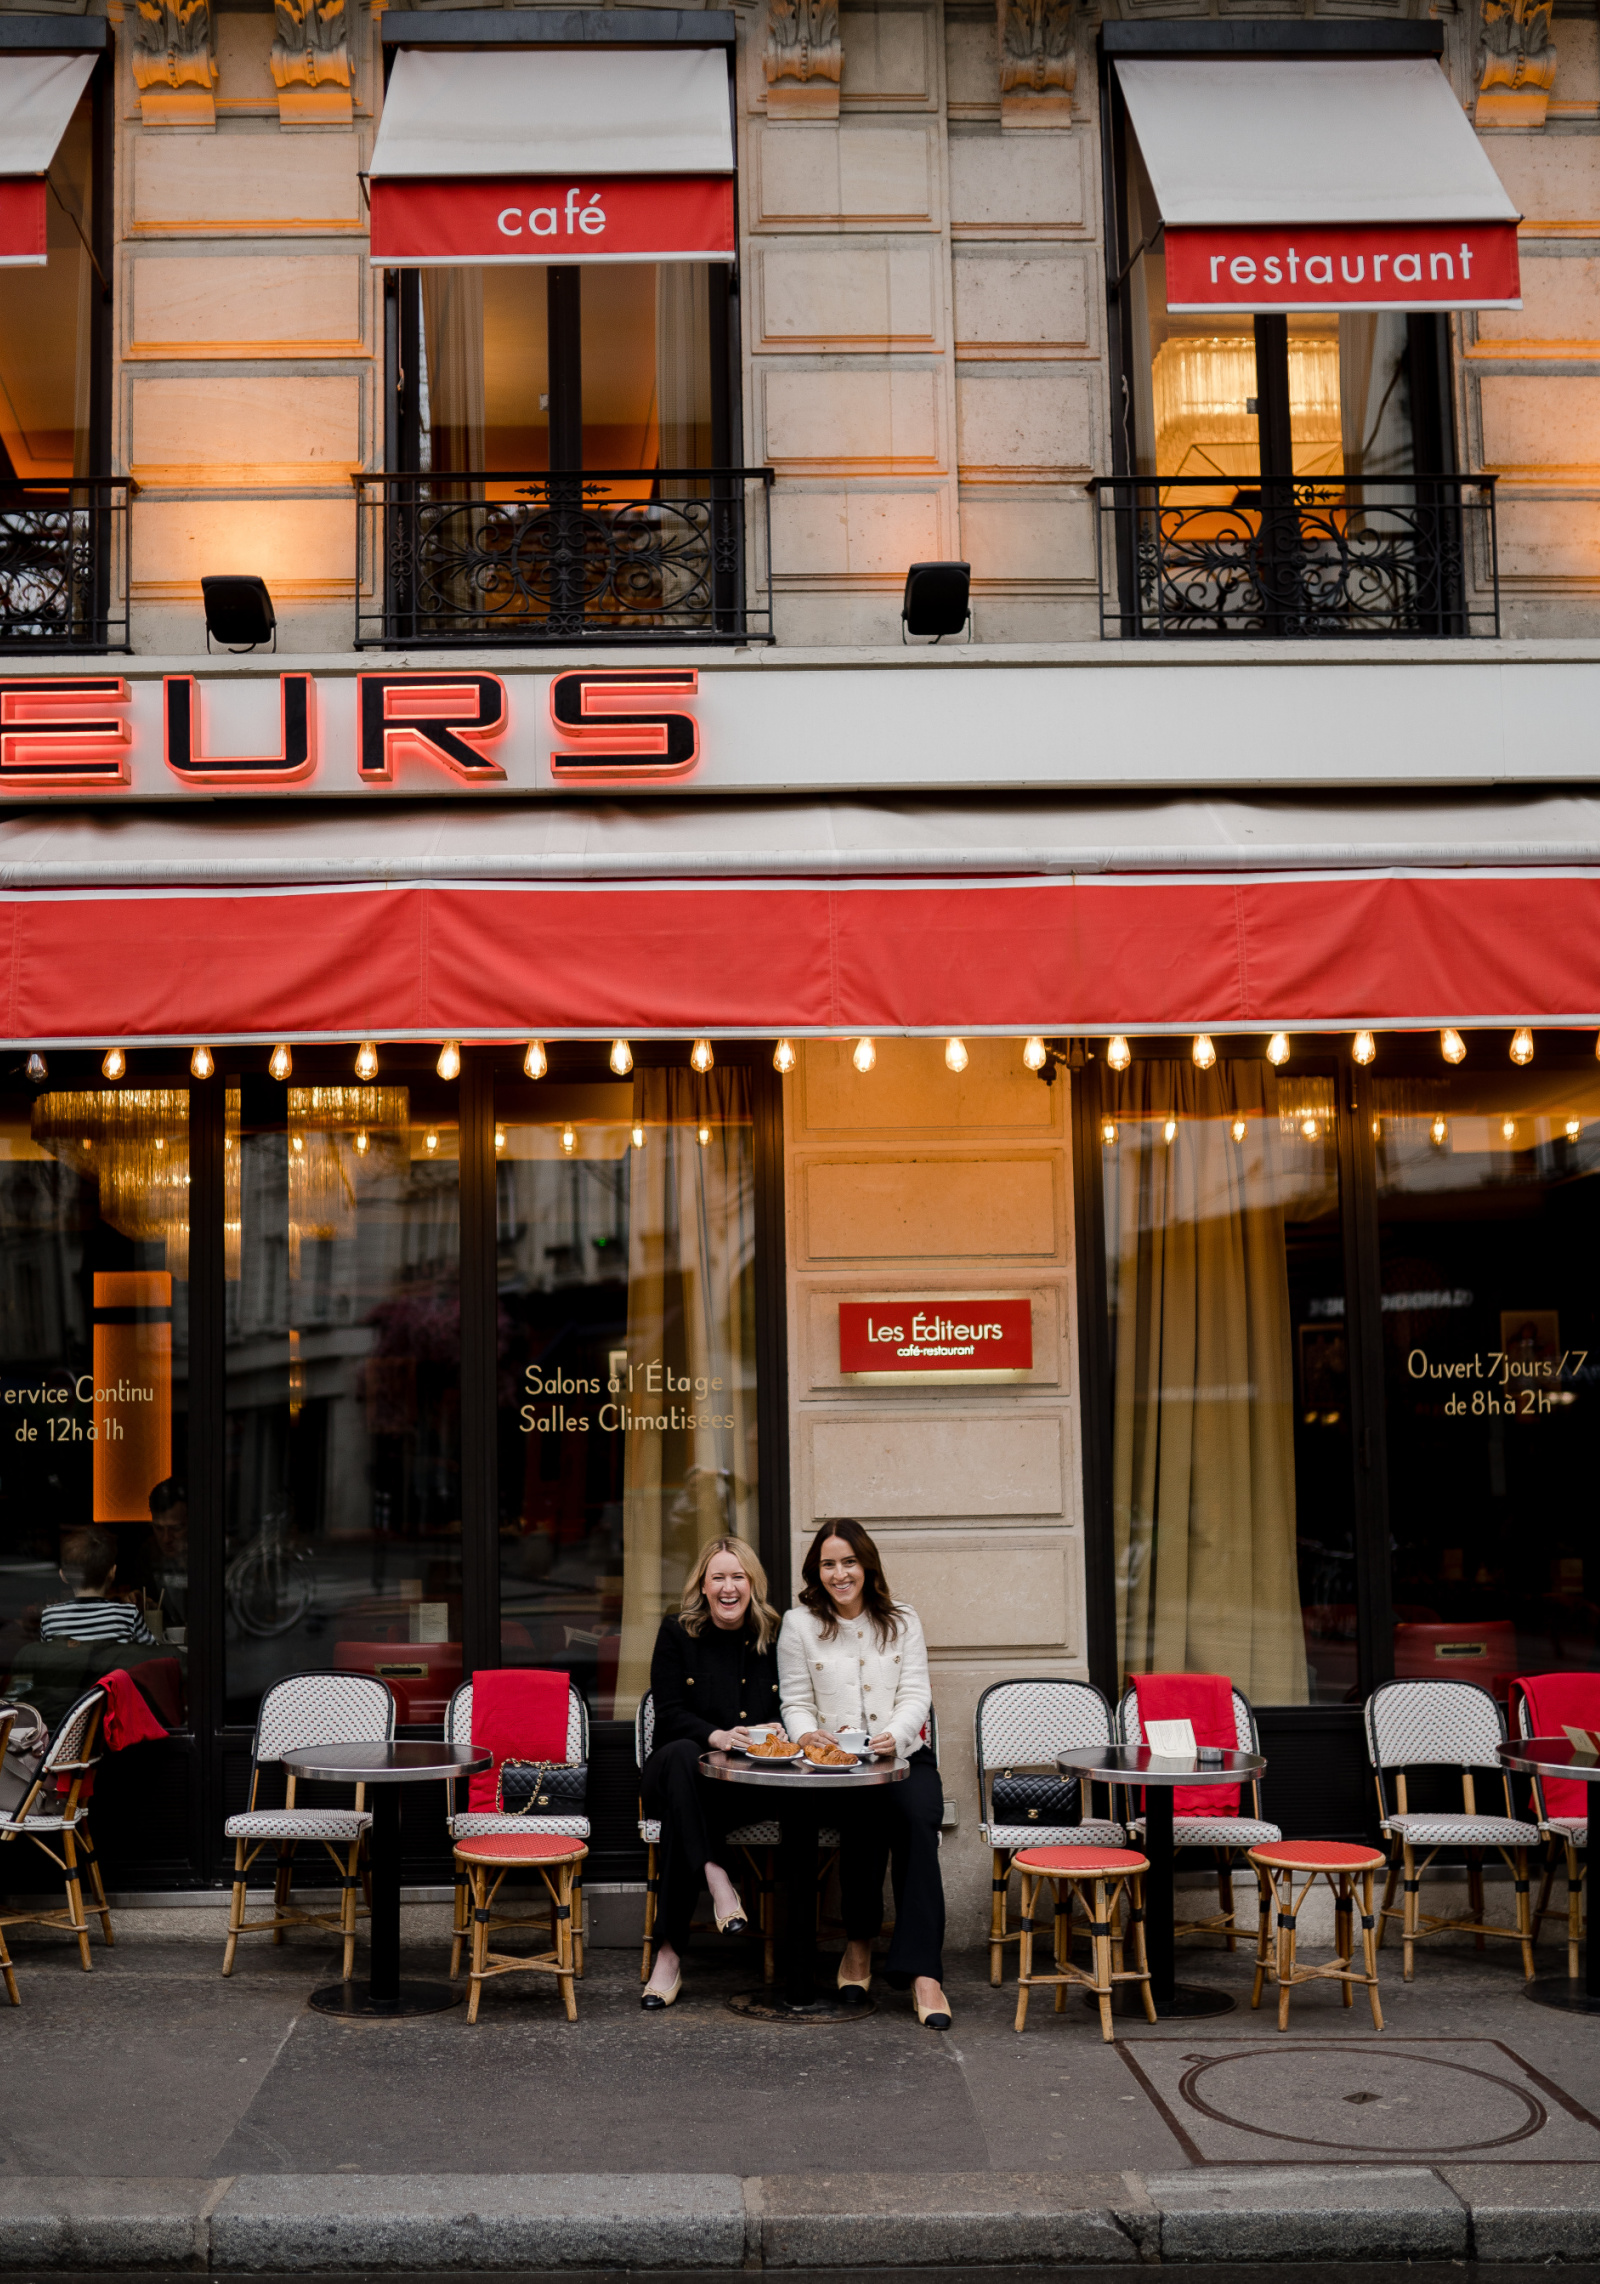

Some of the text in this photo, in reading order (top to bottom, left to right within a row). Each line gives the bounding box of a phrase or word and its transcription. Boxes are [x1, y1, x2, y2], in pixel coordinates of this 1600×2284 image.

[497, 187, 606, 236] café
[1209, 243, 1473, 285] restaurant
[0, 668, 700, 788] EURS
[867, 1311, 1004, 1343] Les Éditeurs
[896, 1343, 975, 1357] café-restaurant
[1407, 1348, 1484, 1379] Ouvert
[0, 1375, 154, 1404] ervice Continu
[524, 1364, 601, 1395] Salons
[607, 1372, 620, 1393] à
[1444, 1391, 1467, 1415] de
[1520, 1389, 1551, 1414] 2h
[15, 1418, 38, 1442] de
[102, 1417, 124, 1441] 1h
[518, 1403, 736, 1433] Salles Climatisées
